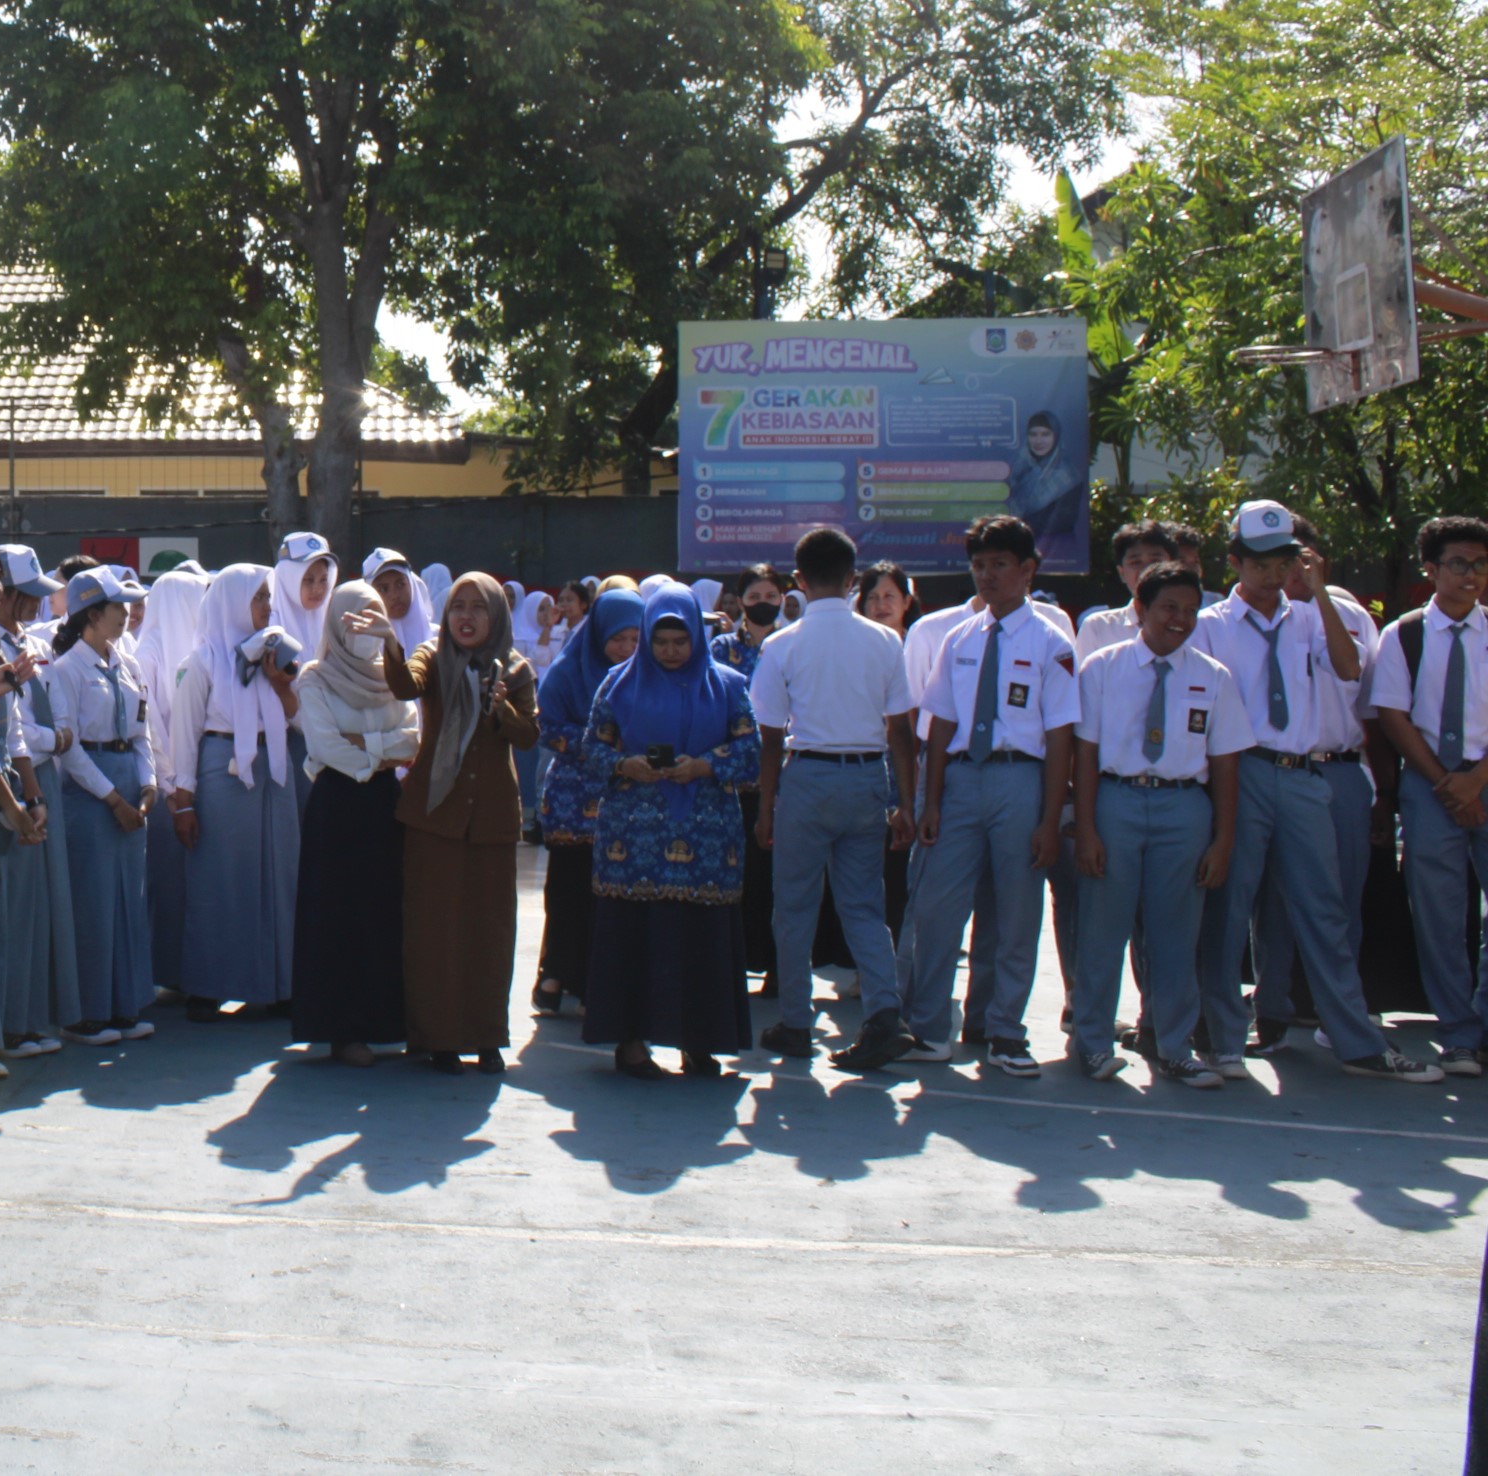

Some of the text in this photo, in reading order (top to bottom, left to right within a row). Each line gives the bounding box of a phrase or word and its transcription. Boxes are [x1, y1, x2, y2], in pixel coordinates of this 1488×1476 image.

[693, 338, 917, 377] YUK, MENGENAL
[753, 389, 874, 408] GERAKAN
[699, 389, 745, 447] 7
[742, 411, 875, 429] KEBIASAAN
[744, 436, 771, 445] ANAK
[774, 436, 828, 445] INDONESIA
[830, 436, 860, 445] HEBAT
